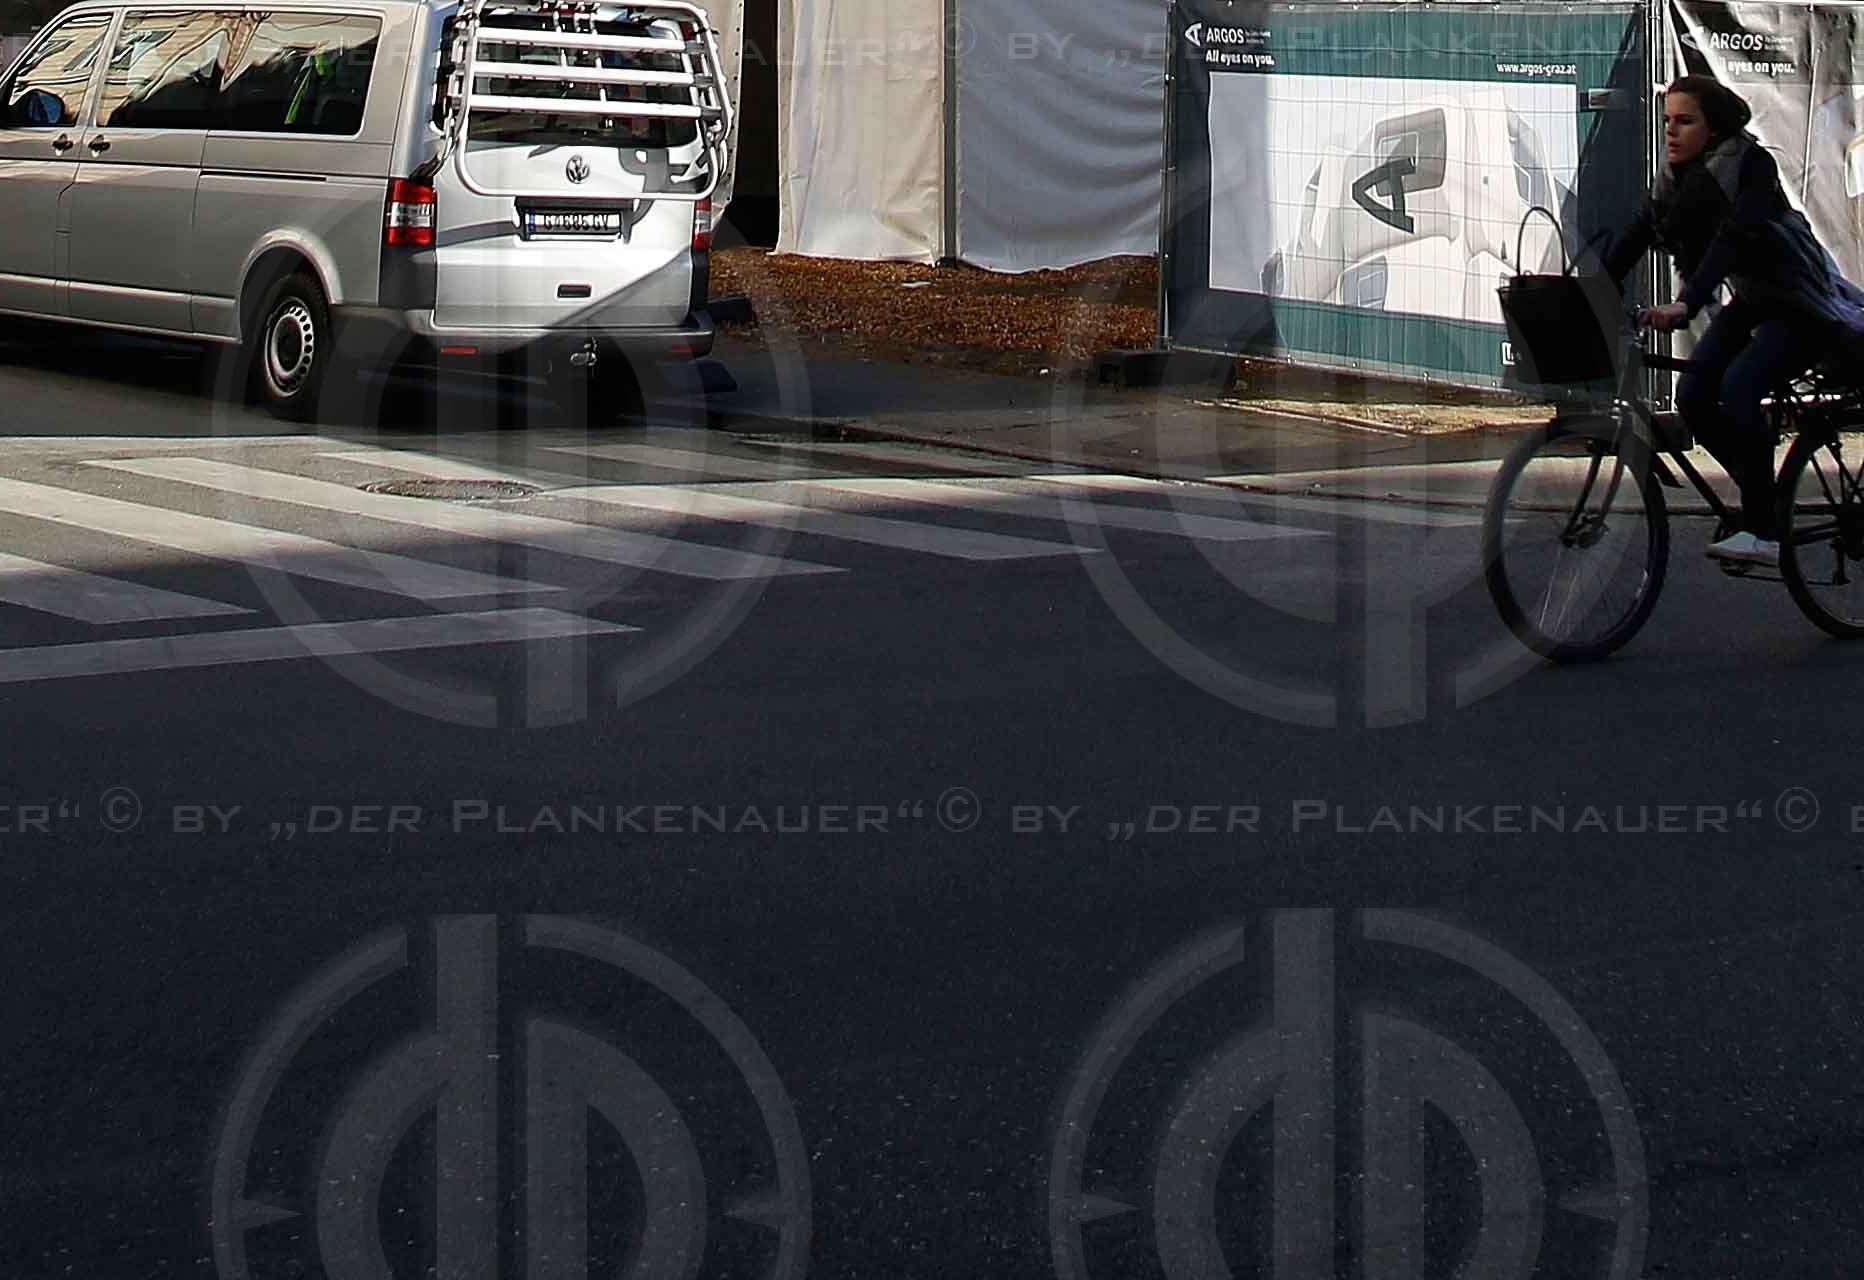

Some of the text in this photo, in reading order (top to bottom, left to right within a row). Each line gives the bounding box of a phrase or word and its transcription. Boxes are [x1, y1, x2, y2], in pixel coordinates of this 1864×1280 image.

[1206, 27, 1244, 44] ARGOS
[1710, 31, 1763, 51] ARGOS
[1206, 49, 1219, 62] All
[1221, 53, 1240, 66] eyes
[1242, 53, 1253, 64] on
[1728, 60, 1752, 75] eyes
[1755, 62, 1769, 73] on
[1771, 62, 1795, 77] you.
